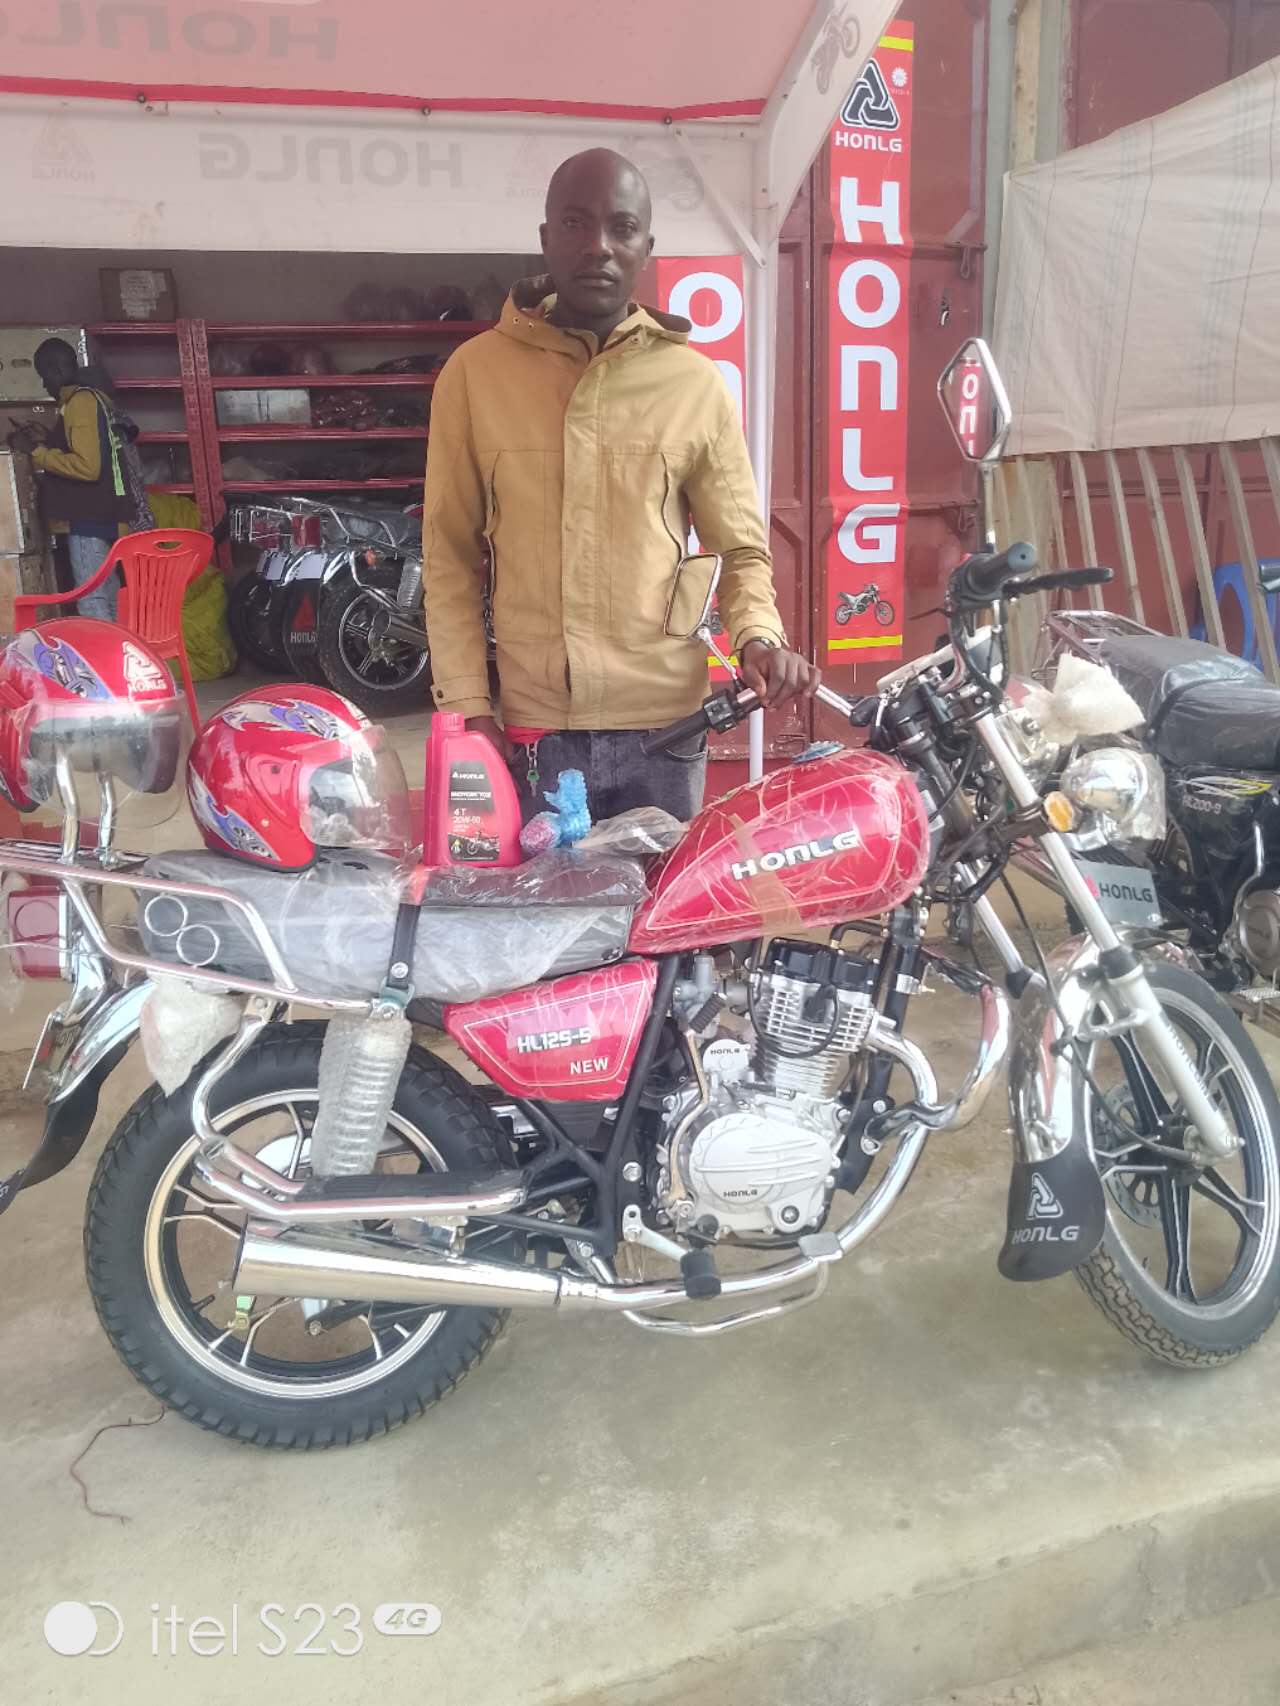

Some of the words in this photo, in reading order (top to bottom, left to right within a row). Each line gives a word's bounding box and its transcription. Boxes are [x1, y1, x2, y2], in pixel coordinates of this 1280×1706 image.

[834, 130, 903, 153] HONLG
[837, 175, 904, 563] HONLG
[731, 829, 860, 881] HONLG
[1099, 882, 1154, 903] HONLG
[569, 1057, 609, 1075] NEW
[1011, 1224, 1081, 1245] HONLG
